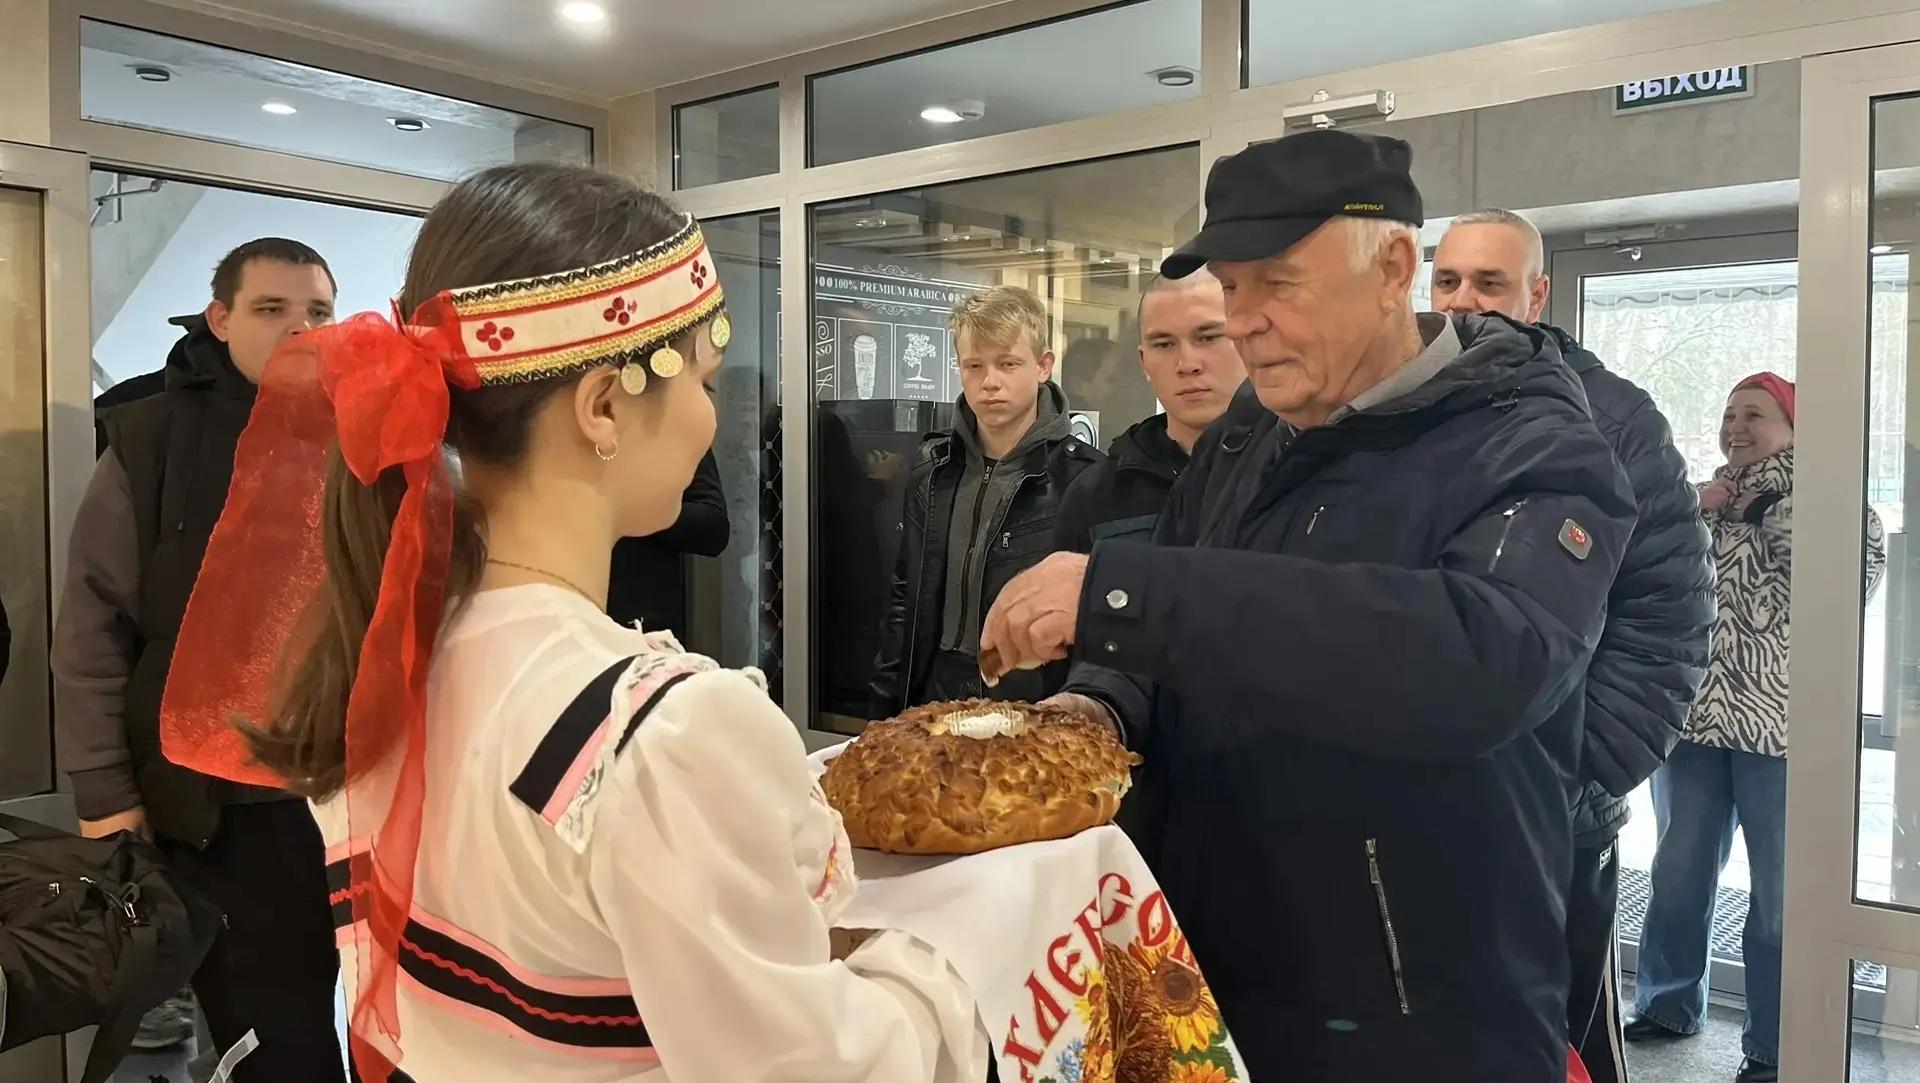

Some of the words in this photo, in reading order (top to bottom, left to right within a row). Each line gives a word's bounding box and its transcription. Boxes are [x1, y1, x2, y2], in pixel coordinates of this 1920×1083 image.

[1623, 66, 1743, 102] ВЫХОД
[834, 278, 858, 291] 100%
[860, 281, 905, 297] PREMIUM
[906, 287, 947, 302] ARABICA
